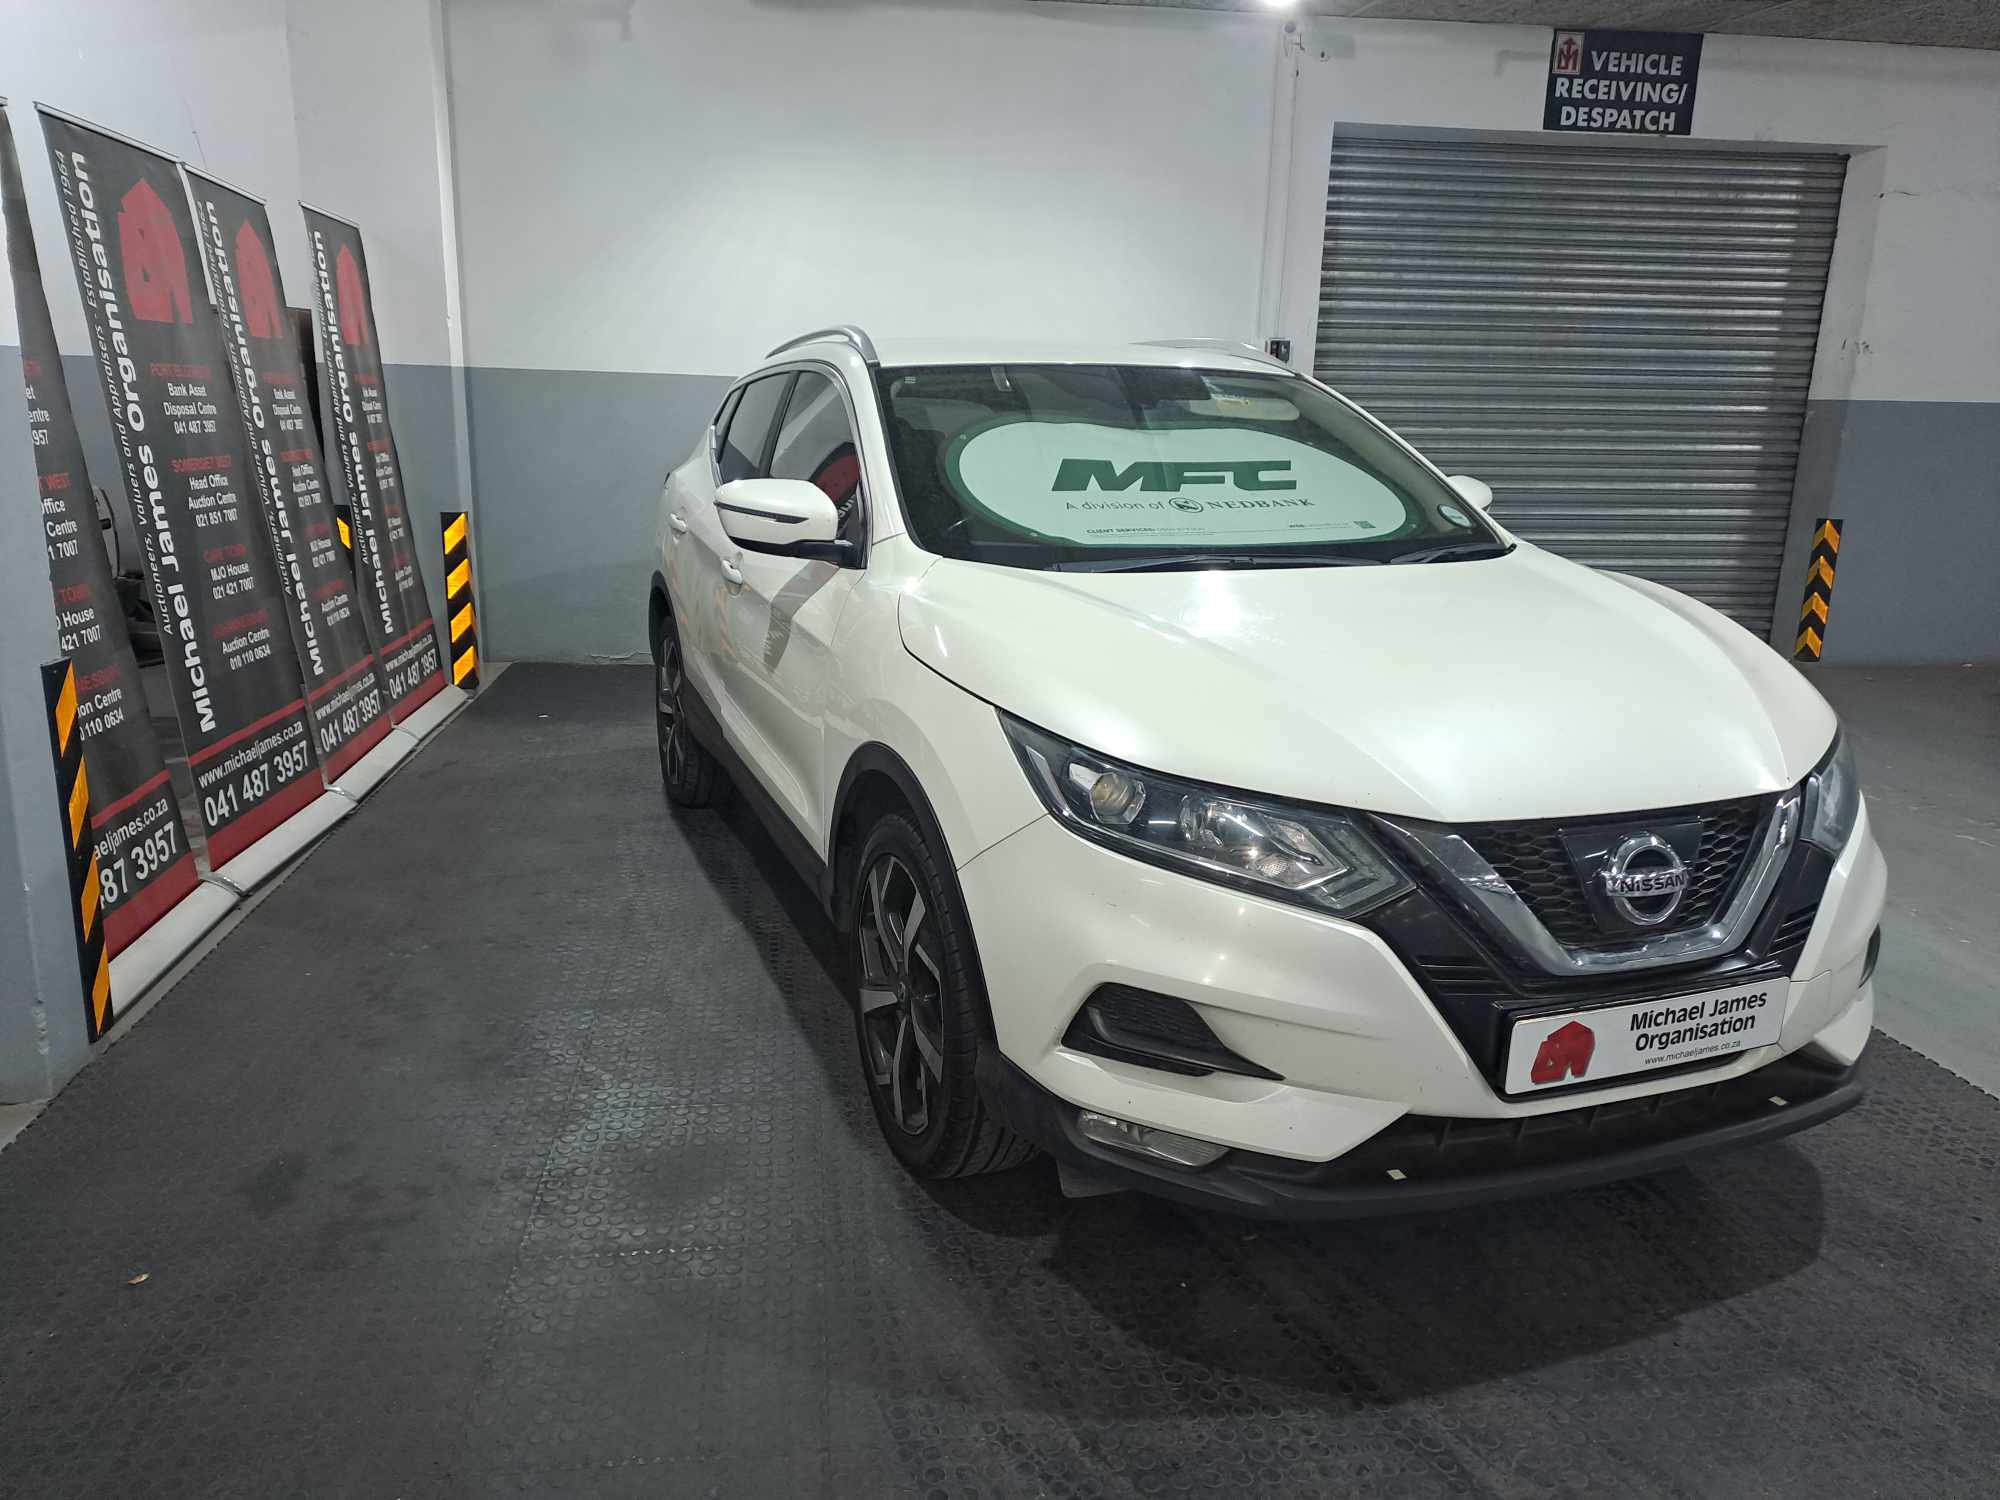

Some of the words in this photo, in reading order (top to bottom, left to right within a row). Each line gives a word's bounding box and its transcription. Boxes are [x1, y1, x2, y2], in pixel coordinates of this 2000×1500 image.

[1591, 51, 1683, 76] VEHICLE
[1555, 77, 1688, 105] RECEIVING/
[1560, 106, 1676, 131] DESPATCH
[65, 201, 97, 308] Established
[72, 152, 144, 432] Organisation
[206, 201, 265, 429] Organisation
[314, 231, 353, 423] Organisation
[95, 325, 124, 419] Appraisers
[168, 383, 187, 396] Bank
[28, 408, 50, 423] entre
[163, 402, 197, 417] Disposal
[32, 429, 49, 445] 957
[116, 424, 132, 457] and
[174, 420, 187, 434] 041
[188, 420, 201, 433] 487
[189, 476, 208, 491] Head
[349, 431, 372, 520] James
[1051, 458, 1297, 492] MFC
[127, 461, 148, 525] Valuers
[188, 496, 216, 510] Auction
[261, 439, 294, 543] James
[1065, 501, 1075, 511] A
[1082, 500, 1145, 511] division
[1148, 500, 1165, 511] of
[1208, 498, 1316, 511] NEDBANK
[138, 444, 179, 571] James
[196, 513, 208, 528] 021
[209, 511, 222, 525] 851
[46, 519, 78, 537] Centre
[56, 540, 79, 558] 7007
[228, 563, 249, 578] House
[365, 529, 394, 634] Michael
[213, 585, 225, 600] 021
[62, 607, 95, 628] House
[286, 553, 324, 676] Michael
[61, 634, 80, 651] 421
[80, 625, 101, 646] 7007
[222, 636, 248, 655] Auction
[247, 628, 270, 645] Centre
[167, 584, 216, 733] Michael
[389, 671, 407, 699] 041
[407, 661, 420, 687] 487
[420, 648, 438, 677] 3957
[94, 688, 122, 709] Centre
[86, 717, 103, 738] 110
[104, 707, 124, 730] 0634
[320, 719, 342, 752] 041
[343, 705, 360, 735] 487
[359, 688, 381, 722] 3957
[198, 720, 303, 789] www.michaeljames.co.za
[204, 783, 238, 827] 041
[242, 763, 270, 801] 487
[273, 739, 308, 783] 3957
[94, 798, 168, 860] aeljames.co.za
[100, 857, 128, 909] 87
[131, 821, 176, 880] 3957
[1620, 874, 1685, 892] NISSAN
[1630, 1001, 1706, 1031] Michael
[1709, 992, 1768, 1017] James
[1635, 1014, 1756, 1051] Organisation
[1645, 1040, 1741, 1065] www.michaeljames.co.za
